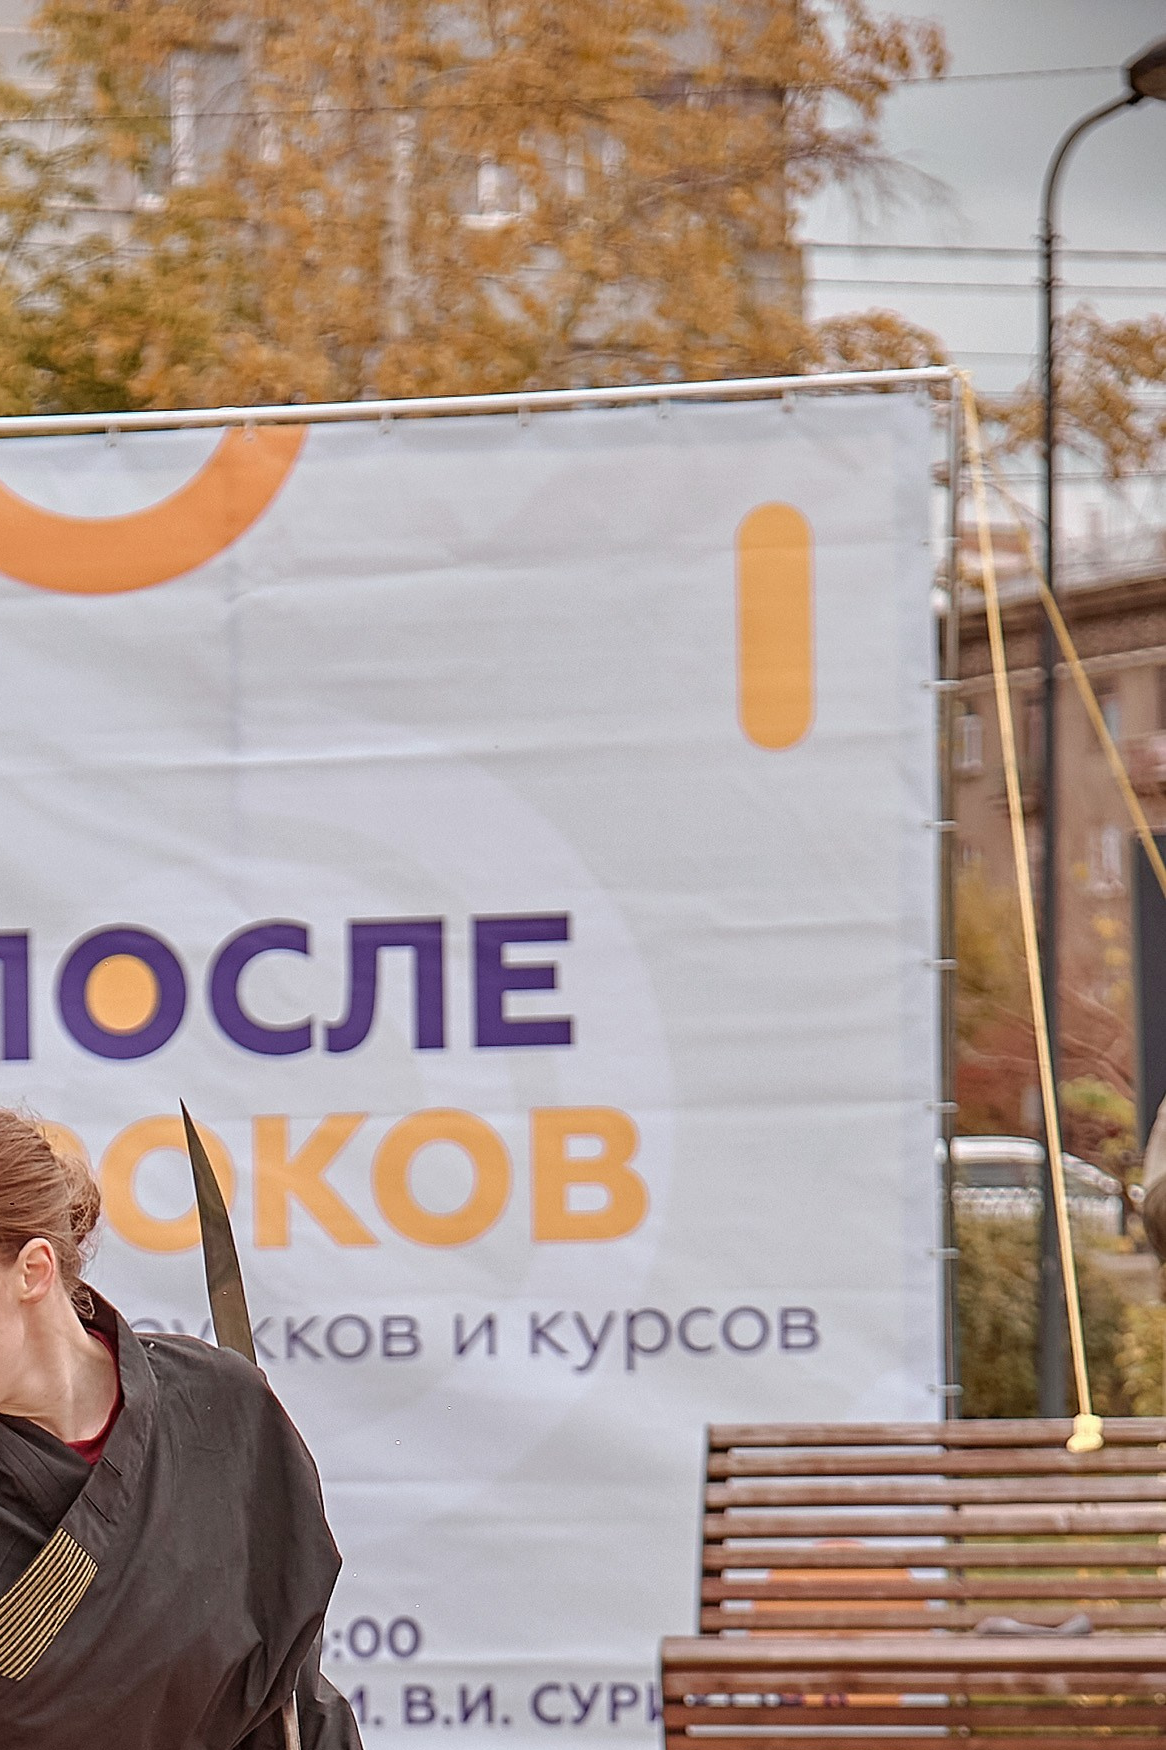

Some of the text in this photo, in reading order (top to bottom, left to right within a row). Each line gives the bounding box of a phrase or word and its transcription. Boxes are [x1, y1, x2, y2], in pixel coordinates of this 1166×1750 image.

[454, 1313, 498, 1358] и
[529, 1306, 821, 1373] курсов
[322, 1616, 423, 1660] :00
